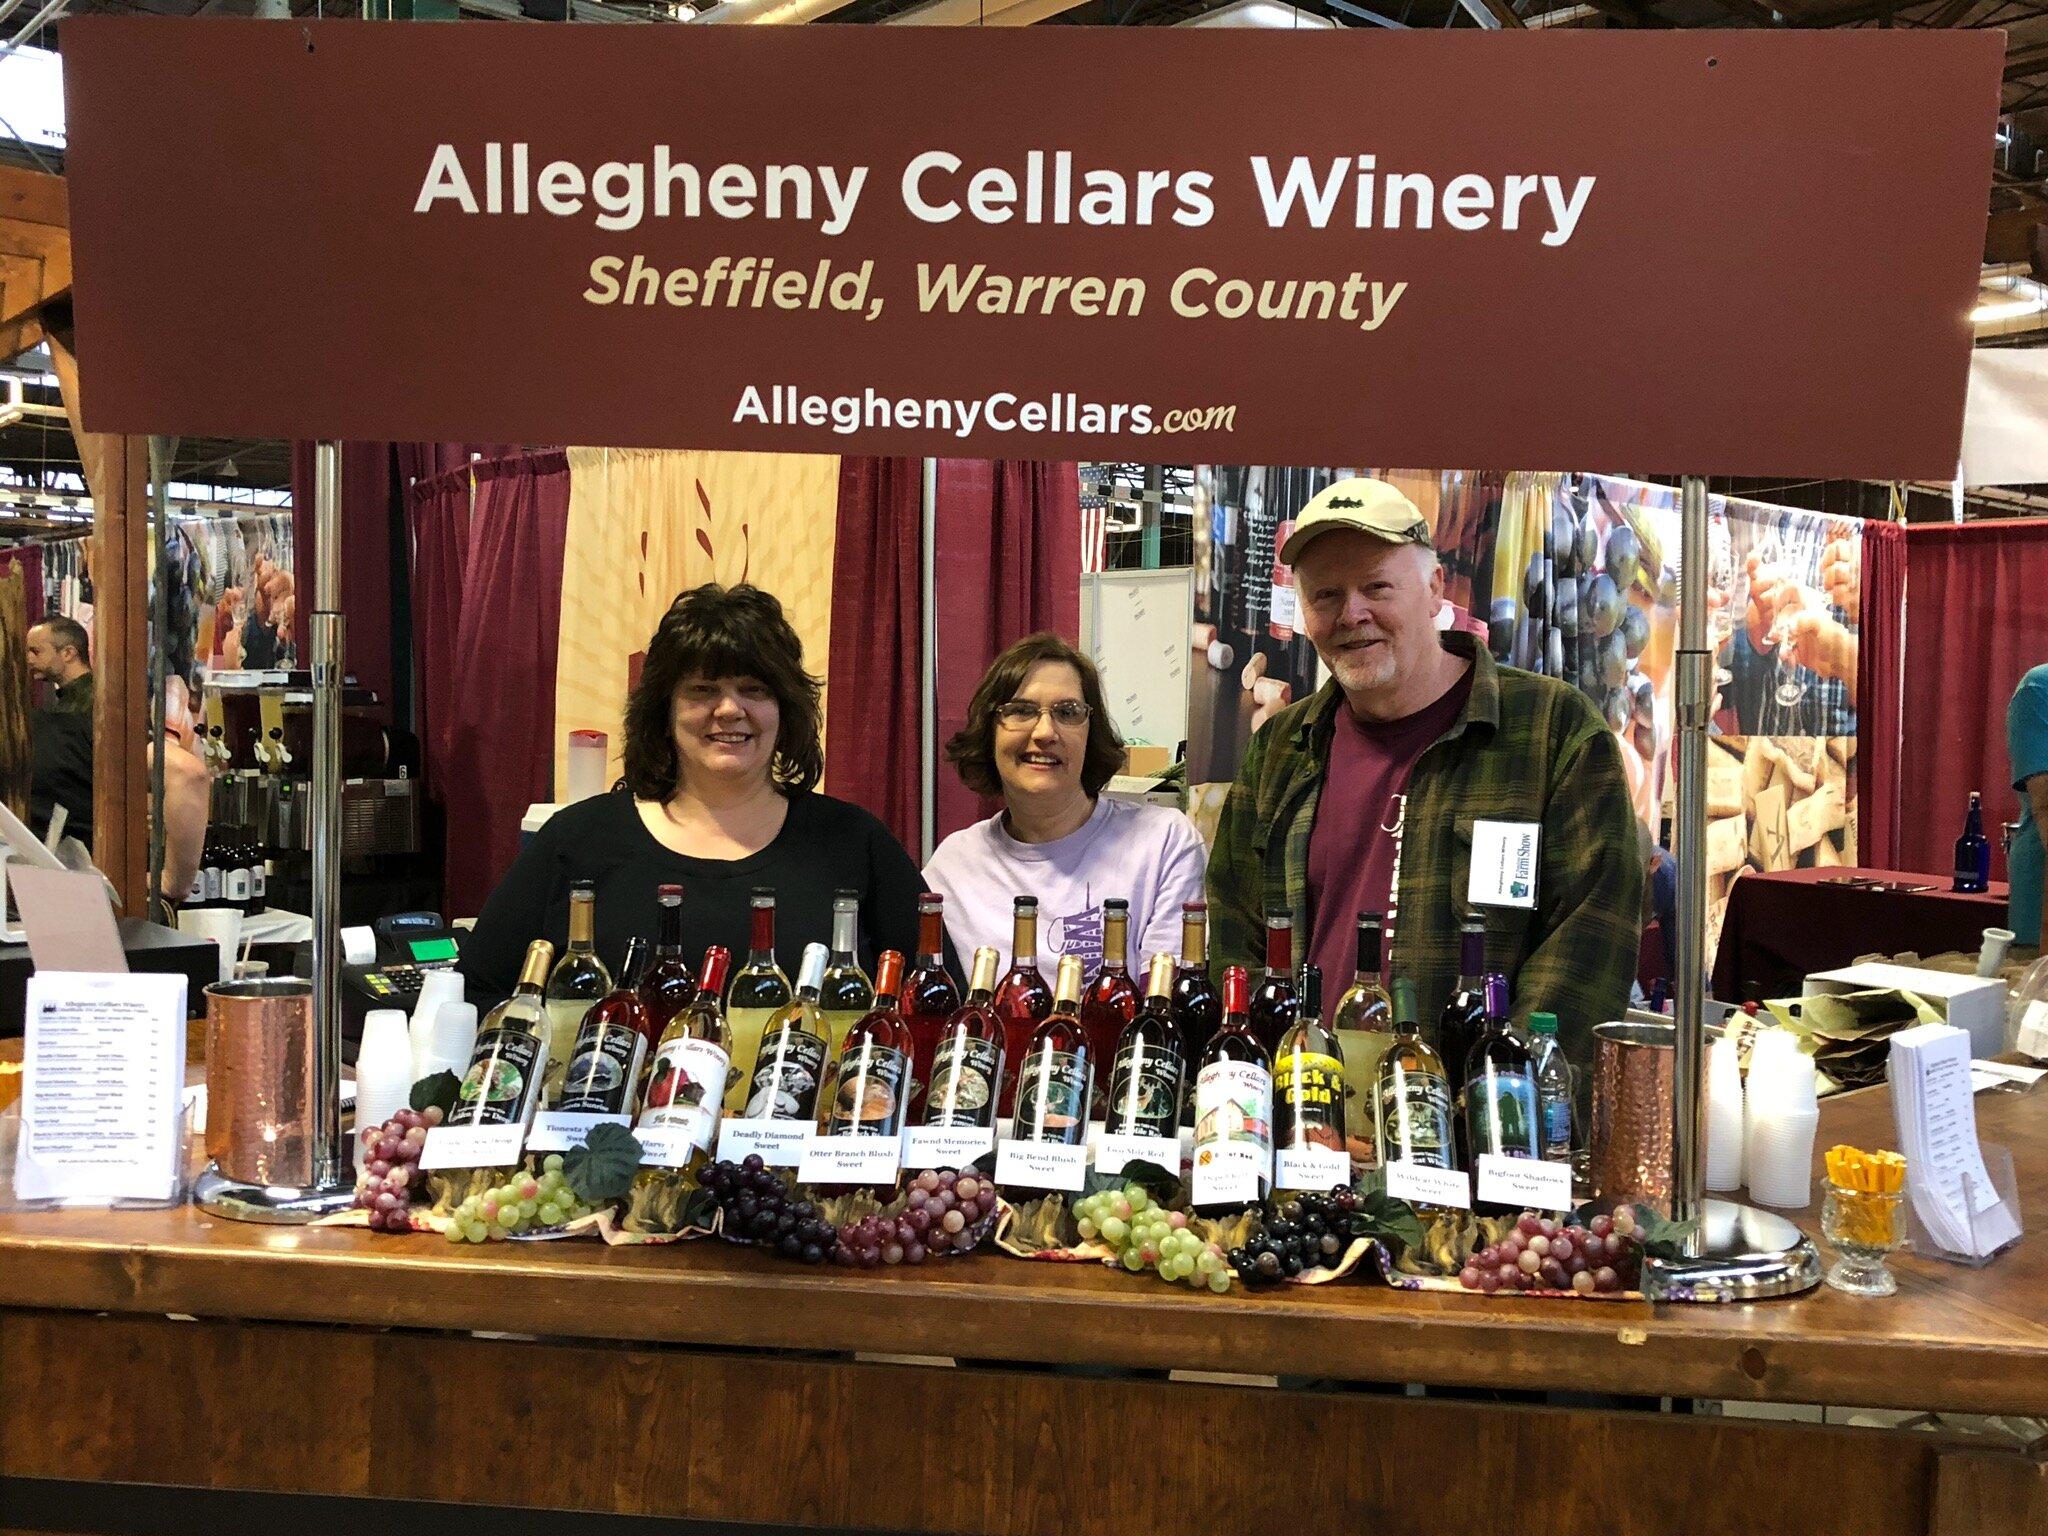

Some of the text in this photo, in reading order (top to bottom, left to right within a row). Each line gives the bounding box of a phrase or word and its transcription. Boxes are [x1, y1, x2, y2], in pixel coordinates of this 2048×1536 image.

[413, 142, 1597, 247] Allegheny Cellars Winery
[582, 254, 1409, 331] Sheffield, Warren County
[732, 384, 1237, 438] AlleghenyCellars.com
[1515, 832, 1531, 880] Farm Show
[1275, 1069, 1325, 1091] Blck
[547, 1125, 582, 1133] Tionesta
[733, 1130, 805, 1140] Deadly Diamond
[809, 1150, 832, 1158] Otter
[834, 1150, 866, 1158] Branch
[836, 1160, 863, 1168] Sweet
[1523, 1173, 1564, 1184] Shadows
